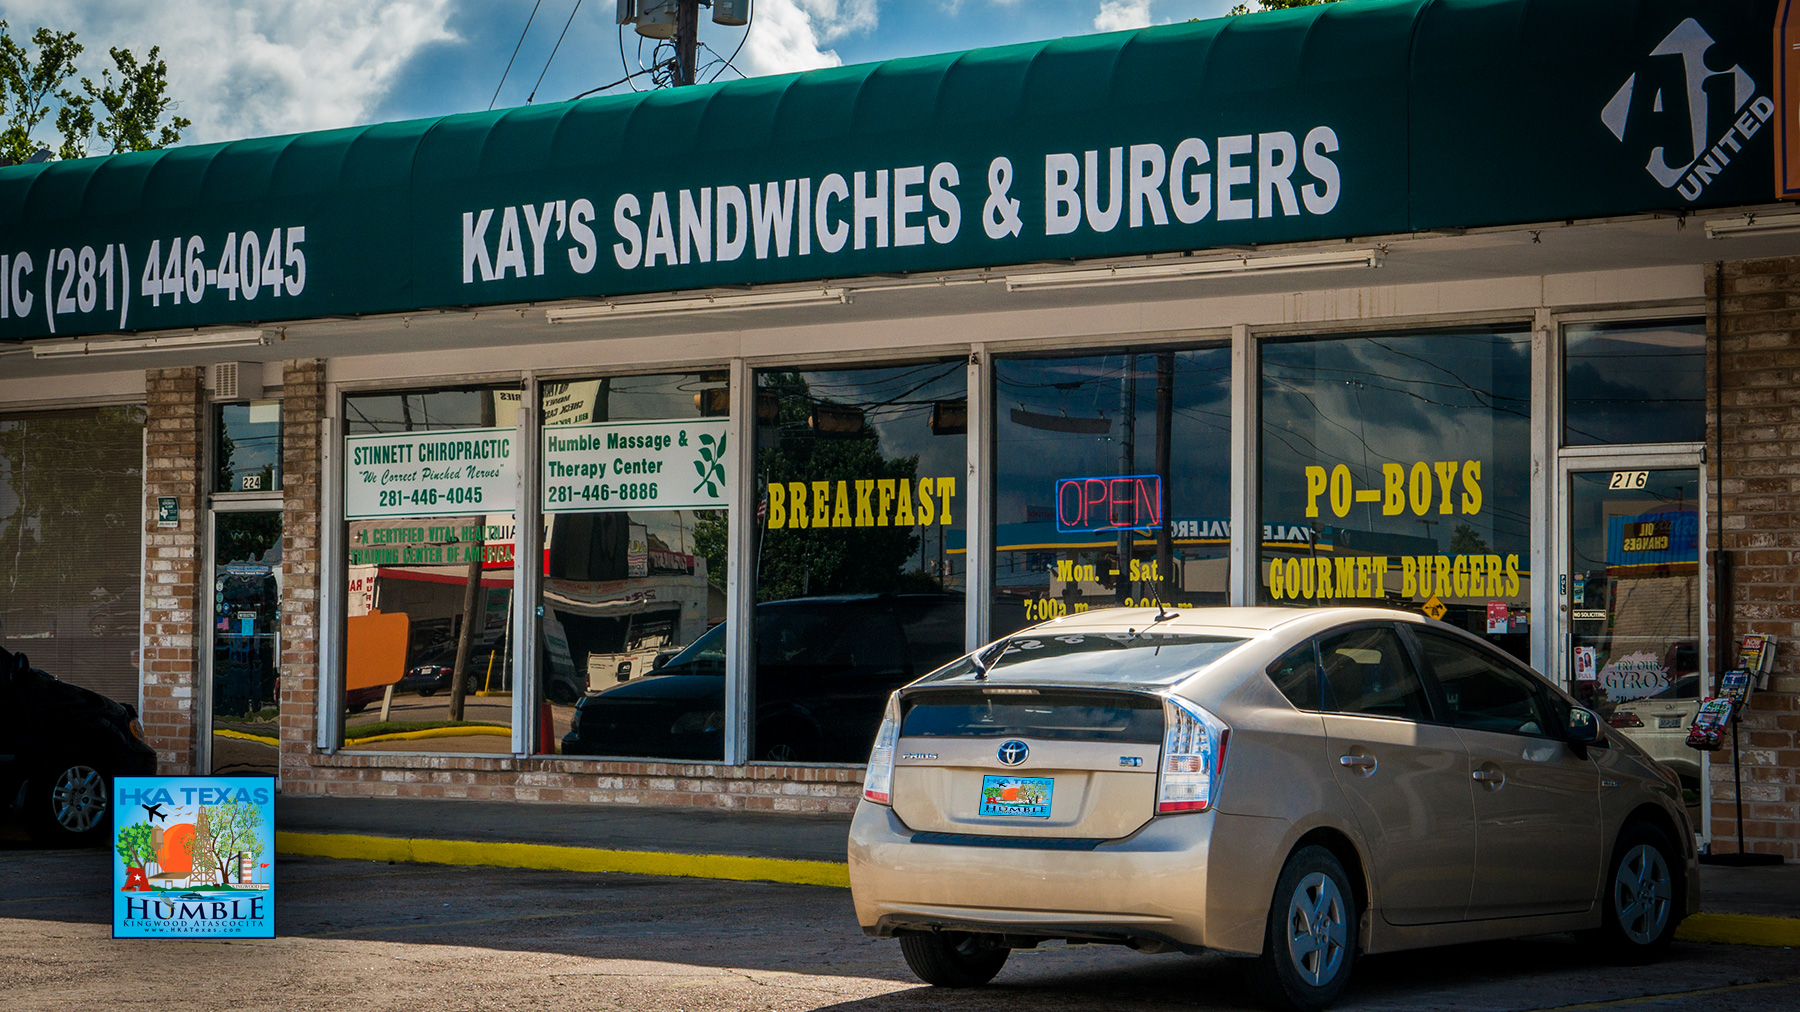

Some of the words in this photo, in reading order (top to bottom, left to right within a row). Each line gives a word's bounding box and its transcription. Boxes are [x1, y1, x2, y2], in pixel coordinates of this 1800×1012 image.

[1676, 95, 1775, 201] UNITED
[462, 198, 597, 283] KAY'S
[613, 161, 961, 270] SANDWICHES
[982, 156, 1023, 239] &
[1045, 126, 1341, 236] BURGERS
[45, 243, 130, 333] (281)
[141, 226, 306, 307] 446-4045
[548, 434, 601, 452] Humble
[607, 432, 672, 451] Massage
[678, 429, 689, 447] &
[354, 443, 413, 466] STINNETT
[418, 438, 510, 463] CHIROPRACTIC
[381, 468, 417, 486] Correct
[421, 466, 462, 482] Pinched
[548, 460, 607, 479] Therapy
[613, 457, 663, 475] Center
[243, 477, 260, 488] 224
[1305, 460, 1482, 518] PO-BOYS
[1612, 472, 1647, 488] 216
[379, 486, 483, 507] 281-446-4045
[548, 482, 658, 503] 281-446-8886
[768, 476, 956, 530] BREAKFAST
[1059, 478, 1160, 527] OPEN
[361, 529, 369, 544] A
[373, 527, 424, 544] CERTIFIED
[428, 526, 459, 543] VITAL
[461, 525, 500, 542] HEALTH
[351, 548, 399, 565] TRAINING
[402, 547, 442, 563] CENTER
[446, 547, 460, 563] OF
[464, 545, 513, 563] AMERICA
[1057, 559, 1100, 582] Mon.
[1129, 558, 1165, 582] Sat.
[1269, 556, 1388, 600] GOURMET
[1401, 553, 1520, 598] BURGERS
[1616, 660, 1635, 671] TRY
[1637, 660, 1662, 671] OUR
[1605, 671, 1671, 689] GYROS
[902, 752, 939, 760] PRIUS
